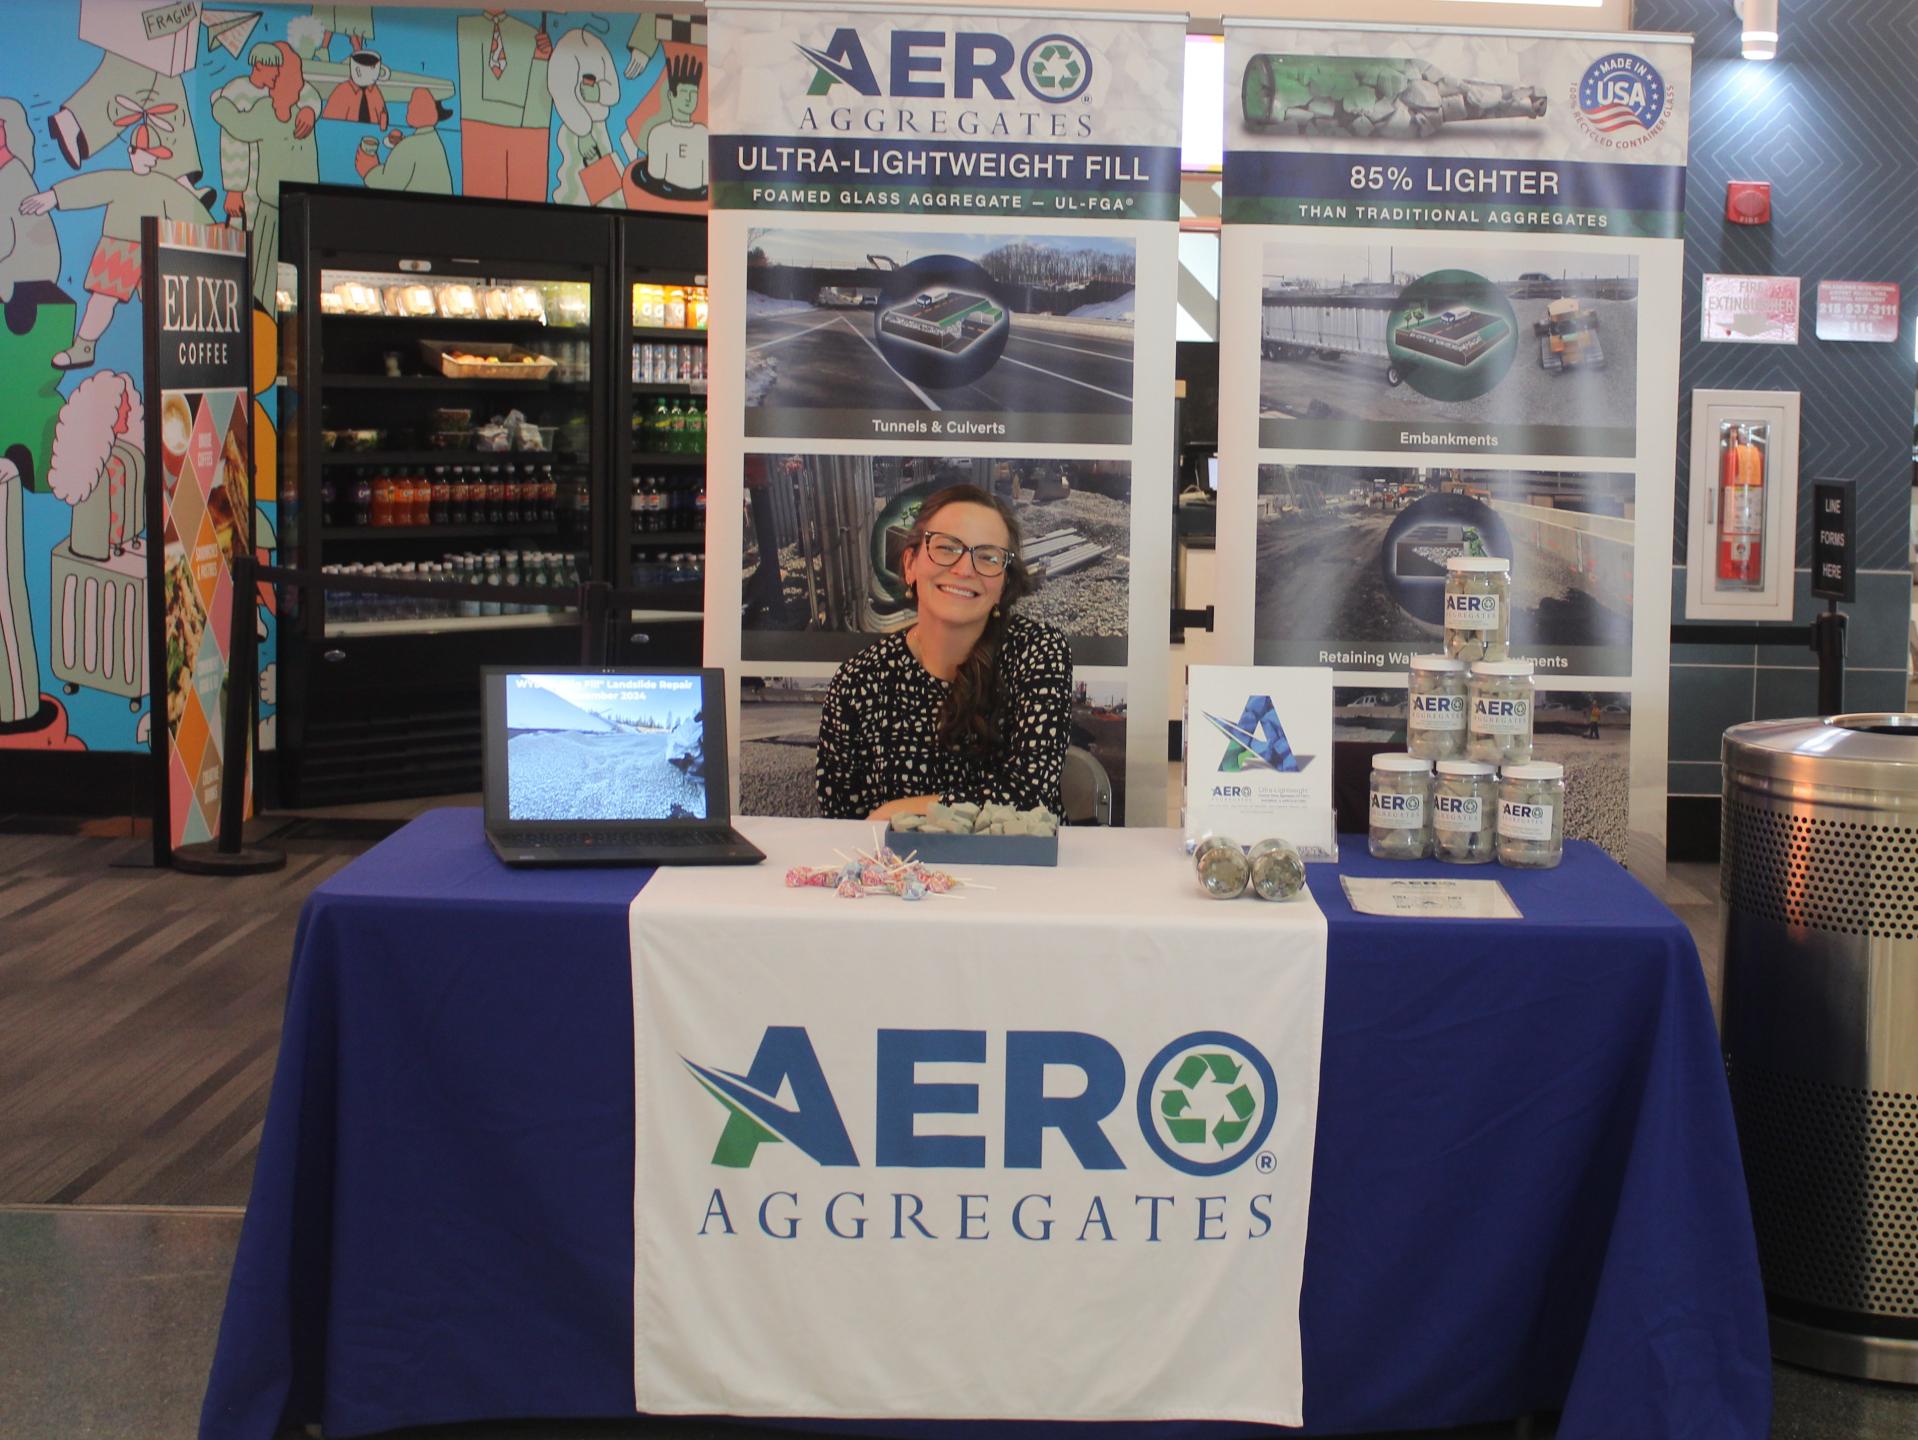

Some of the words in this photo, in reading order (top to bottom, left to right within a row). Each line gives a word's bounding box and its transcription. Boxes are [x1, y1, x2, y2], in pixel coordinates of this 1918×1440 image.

[792, 28, 1092, 104] AERO
[1600, 58, 1632, 74] MADE
[1634, 62, 1648, 77] IN
[1597, 81, 1646, 106] USA
[799, 107, 1092, 137] AGGREGATES
[1573, 111, 1613, 147] RECYCLED
[1616, 119, 1667, 149] CONTAINER
[1664, 84, 1674, 118] GLASS
[738, 147, 1074, 179] ULTRA-LIGHTWEIGHT
[1086, 155, 1149, 181] FILL
[1350, 165, 1412, 191] 85%
[1427, 168, 1559, 195] LIGHTER
[753, 189, 831, 204] FOAMED
[840, 191, 900, 205] GLASS
[909, 194, 1022, 208] AGGREGATE
[1299, 205, 1347, 219] THAN
[1356, 207, 1480, 223] TRADITIONAL
[1488, 212, 1608, 228] AGGREGATES
[1739, 280, 1764, 293] FIRE
[162, 274, 240, 333] ELIXR
[179, 342, 228, 365] COFFEE
[872, 419, 927, 433] Tunnels
[931, 420, 942, 433] &
[947, 420, 1006, 434] Culverts
[1400, 431, 1499, 446] Embankments
[1825, 499, 1841, 514] LINE
[1820, 530, 1845, 547] FORMS
[1823, 563, 1841, 579] HERE
[1447, 595, 1495, 611] AERO
[1319, 651, 1384, 667] Retaining
[1389, 652, 1418, 665] Wall
[1512, 655, 1568, 668] utments
[607, 680, 656, 689] Landslide
[659, 680, 693, 691] Repair
[621, 691, 646, 700] 2024
[1413, 696, 1464, 712] AERO
[1475, 700, 1527, 717] AERO
[1212, 786, 1251, 797] AERO
[1371, 795, 1420, 811] AERO
[1503, 803, 1543, 819] AERO
[675, 1026, 1278, 1177] AERO
[697, 1188, 1273, 1242] AGGREGATES
